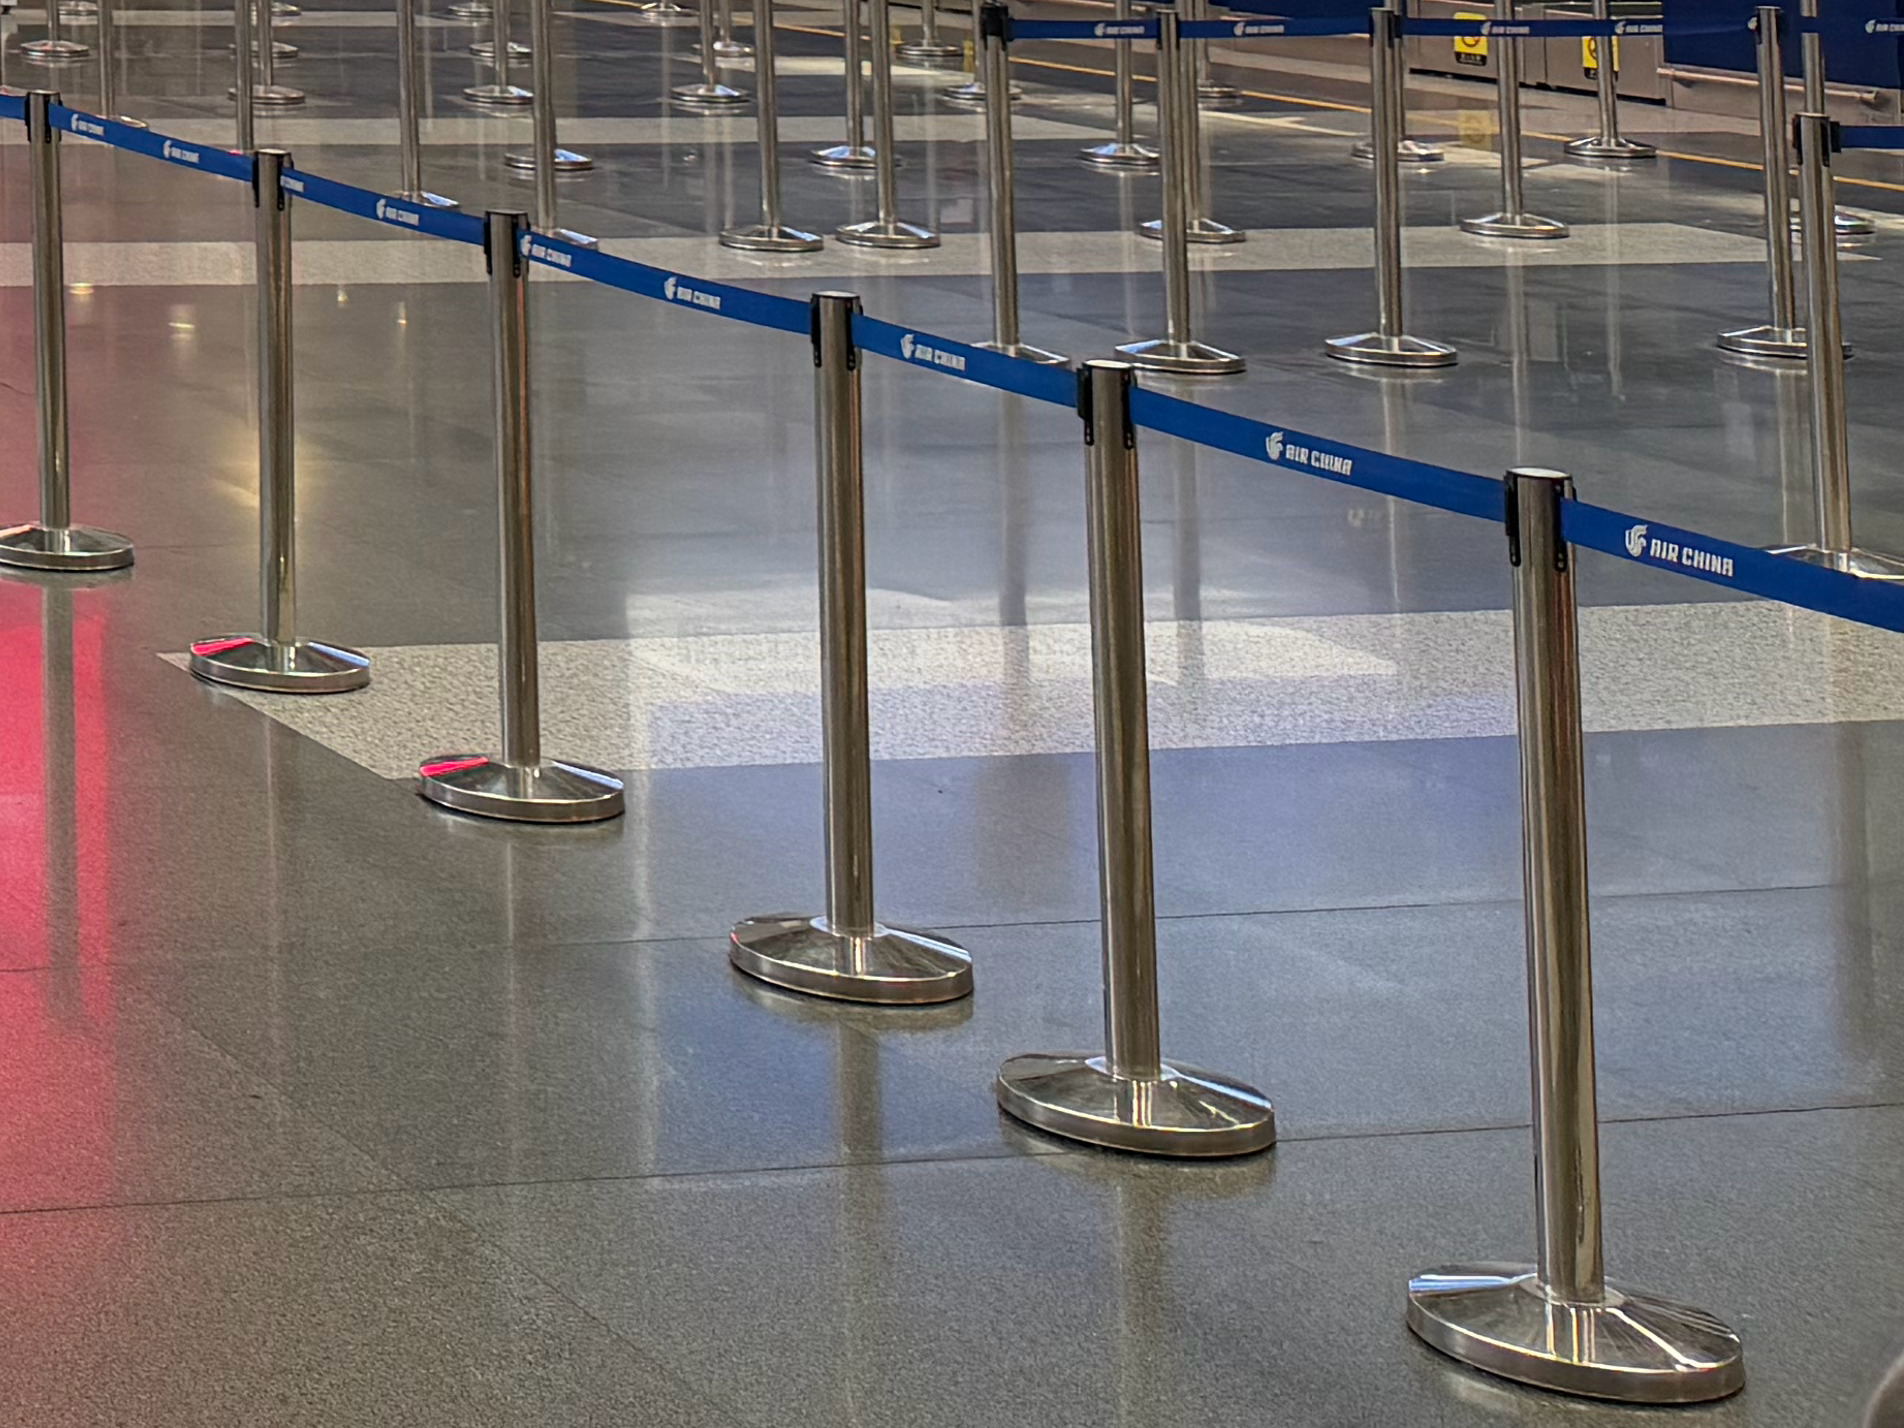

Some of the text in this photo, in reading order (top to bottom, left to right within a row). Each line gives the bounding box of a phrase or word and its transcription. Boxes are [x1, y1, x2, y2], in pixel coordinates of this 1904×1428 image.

[1286, 444, 1353, 477] AIR CHINA
[1650, 538, 1734, 578] AIR CHINA
